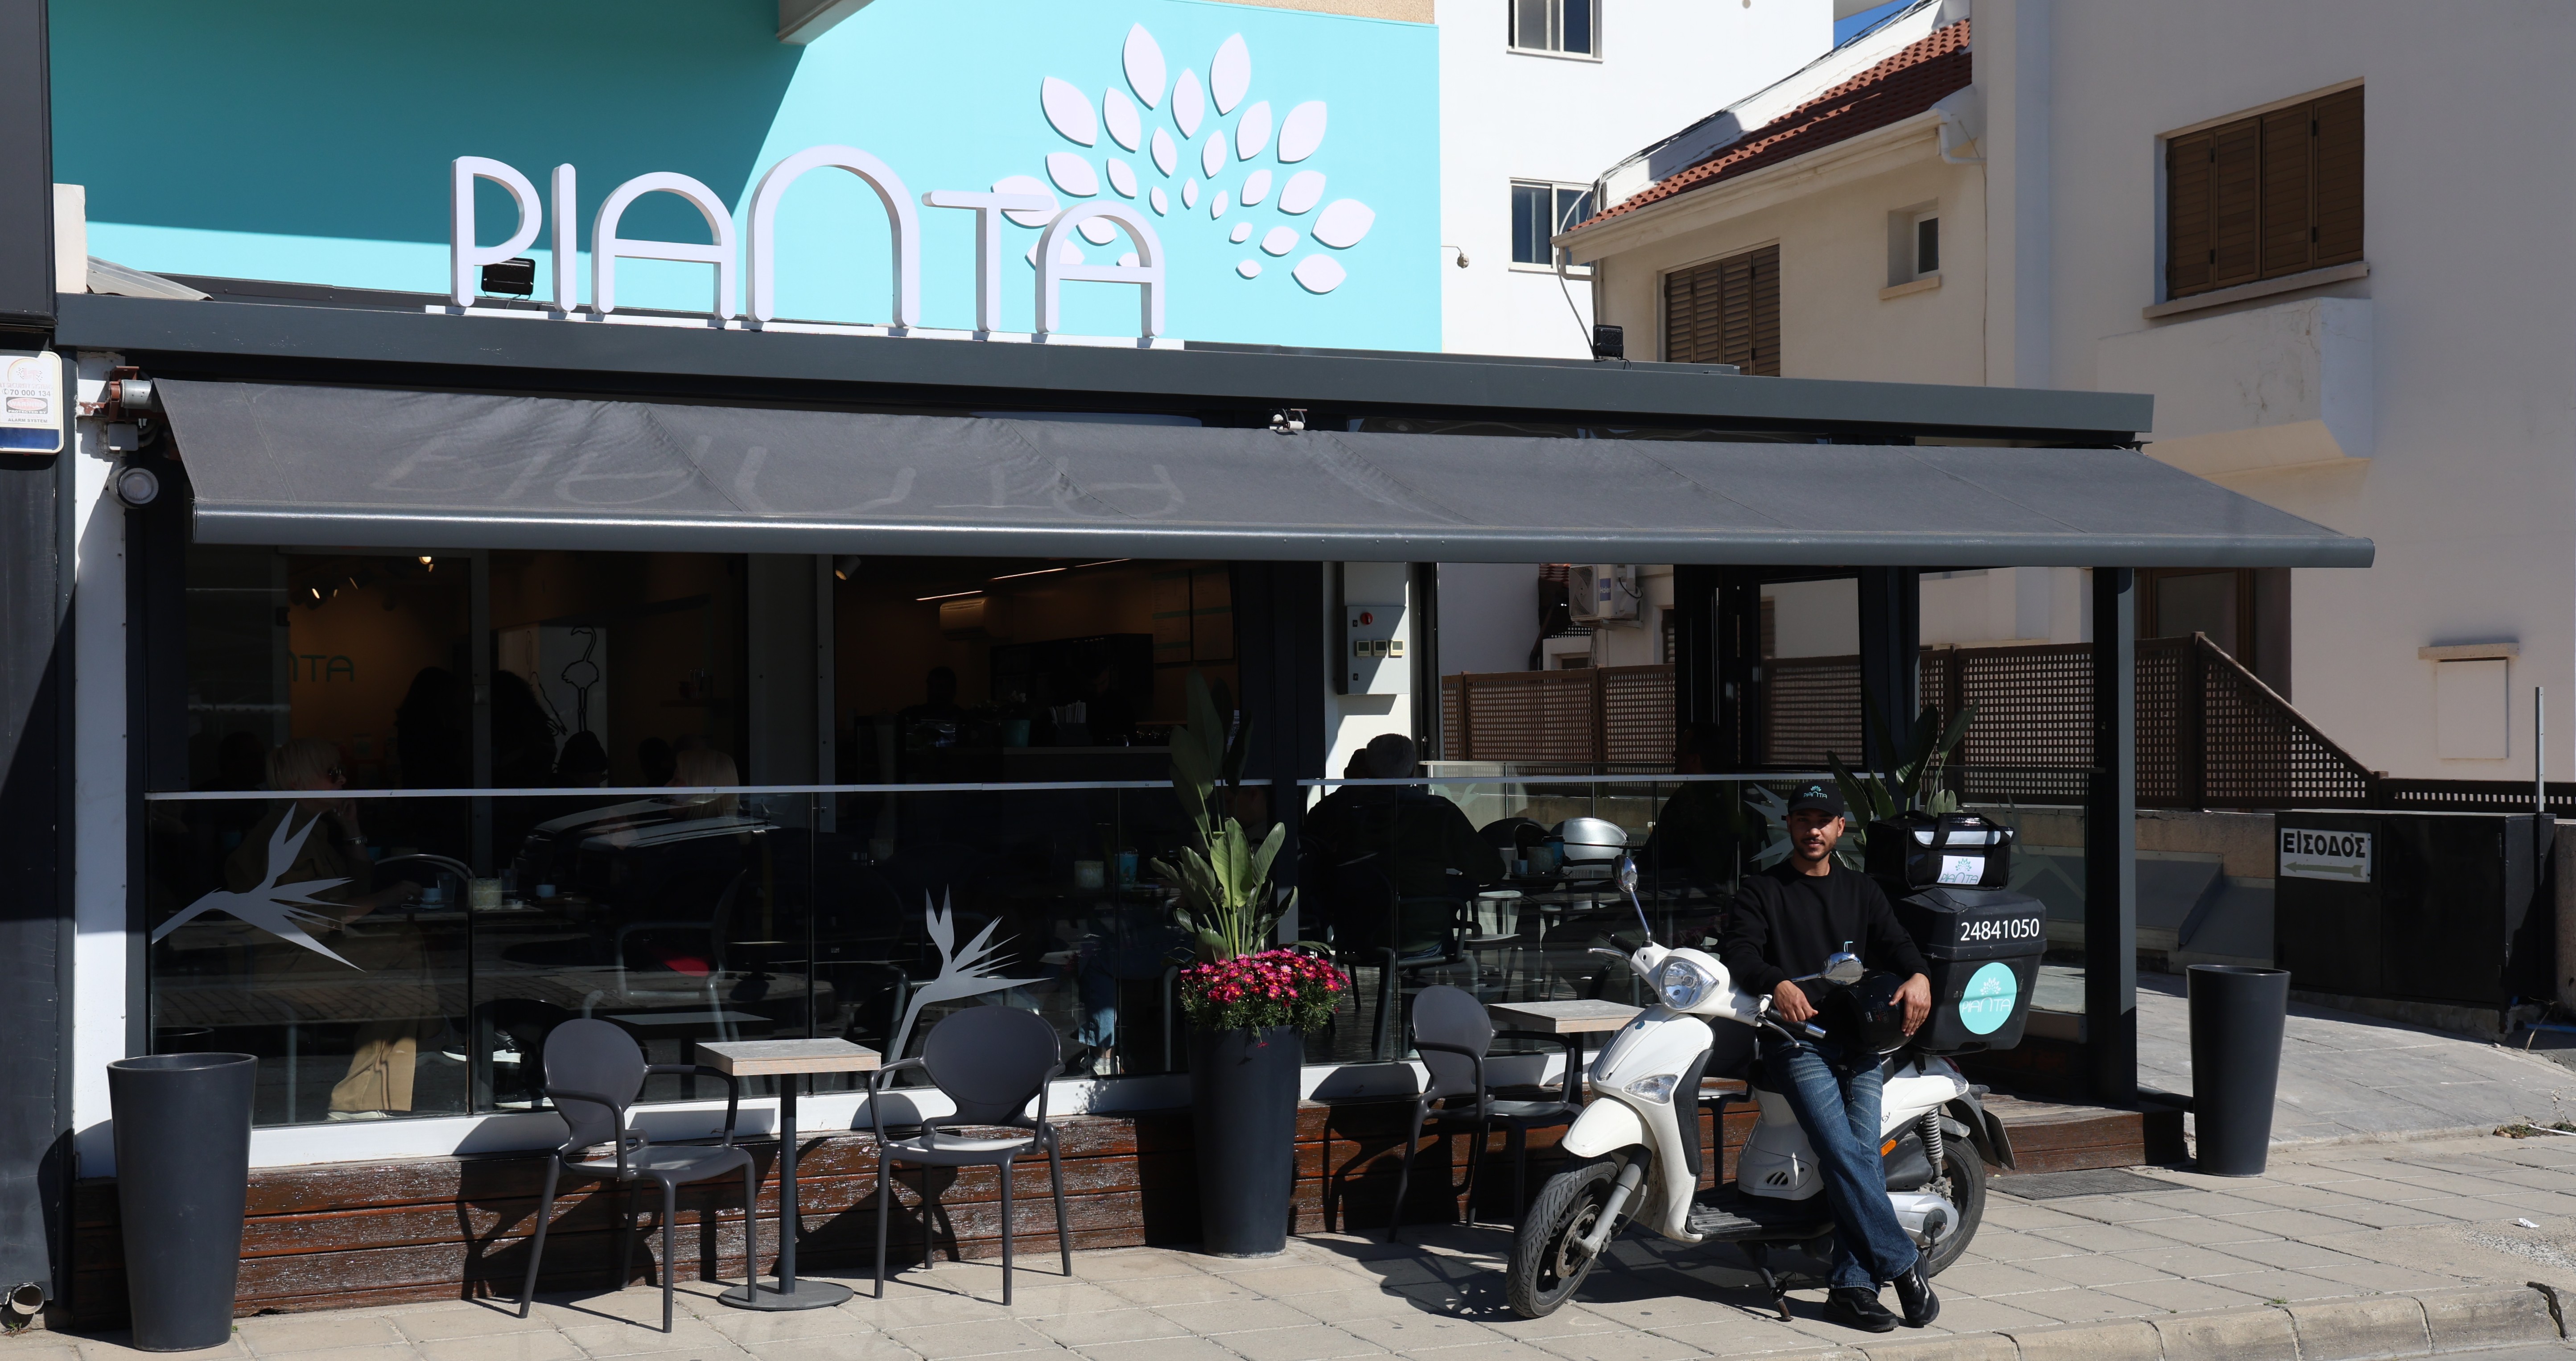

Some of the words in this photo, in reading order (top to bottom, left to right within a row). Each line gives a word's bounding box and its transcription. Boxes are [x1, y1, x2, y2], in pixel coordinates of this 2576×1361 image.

[451, 144, 1165, 339] PIANTA
[2283, 832, 2366, 858] ΕΙΣΟΔΟΣ
[1940, 872, 1979, 884] PIANTA
[1960, 918, 2040, 941] 24841050
[1961, 997, 2011, 1013] PIANTA
